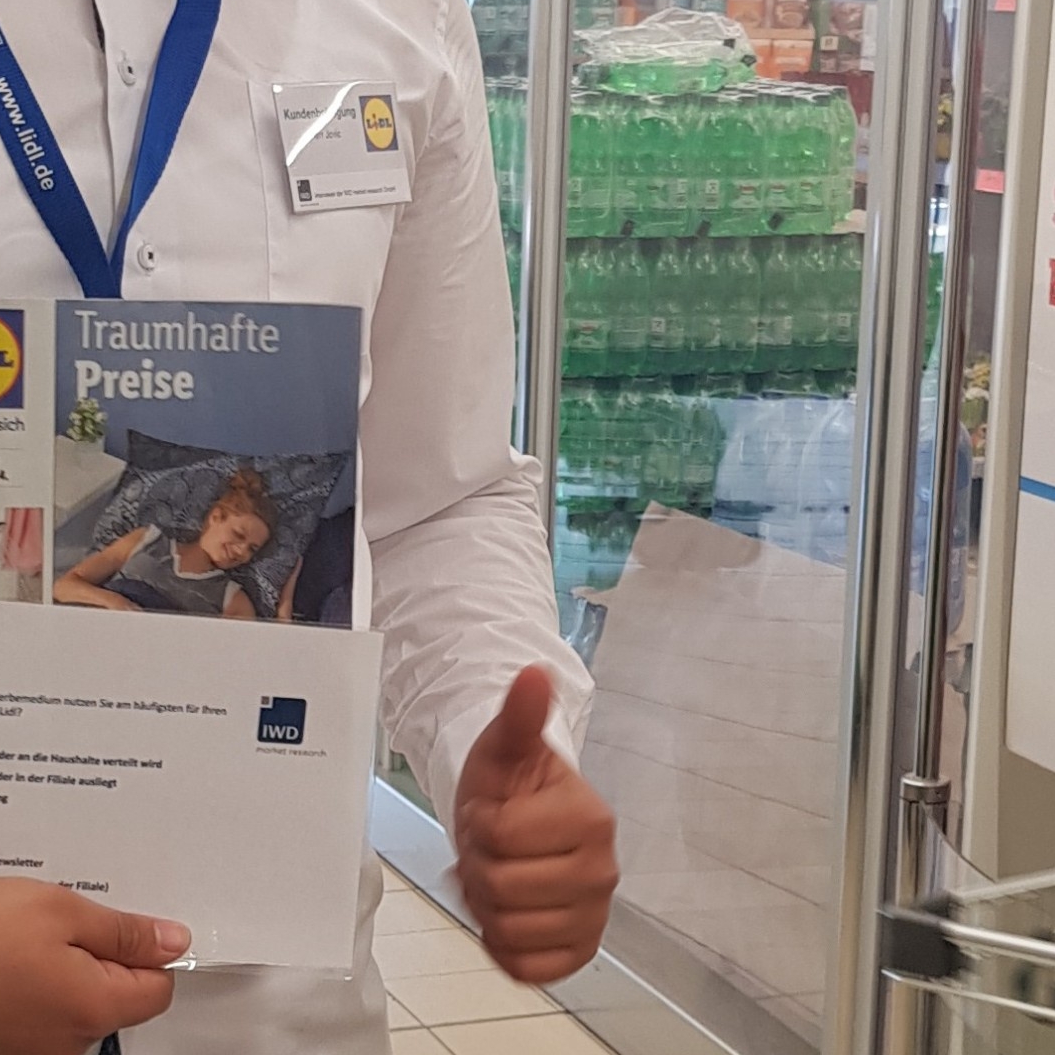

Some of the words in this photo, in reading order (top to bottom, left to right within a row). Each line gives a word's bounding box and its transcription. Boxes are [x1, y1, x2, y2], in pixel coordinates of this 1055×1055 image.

[74, 310, 281, 353] Traumhafte
[75, 358, 195, 400] Preise
[0, 706, 23, 717] Lidl?
[64, 696, 97, 707] nutzen
[99, 699, 114, 708] Sie
[116, 702, 132, 710] am
[134, 701, 184, 714] häufigsten
[186, 704, 200, 714] für
[202, 705, 228, 716] Ihren
[262, 724, 299, 741] IWD
[18, 753, 31, 762] an
[33, 752, 49, 763] die
[51, 754, 101, 766] Haushalte
[103, 757, 139, 768] verteilt
[141, 759, 163, 769] wird
[16, 773, 26, 782] in
[28, 774, 45, 784] der
[47, 774, 77, 785] Filiale
[79, 776, 118, 789] ausliegt
[76, 881, 110, 893] Filiale)
